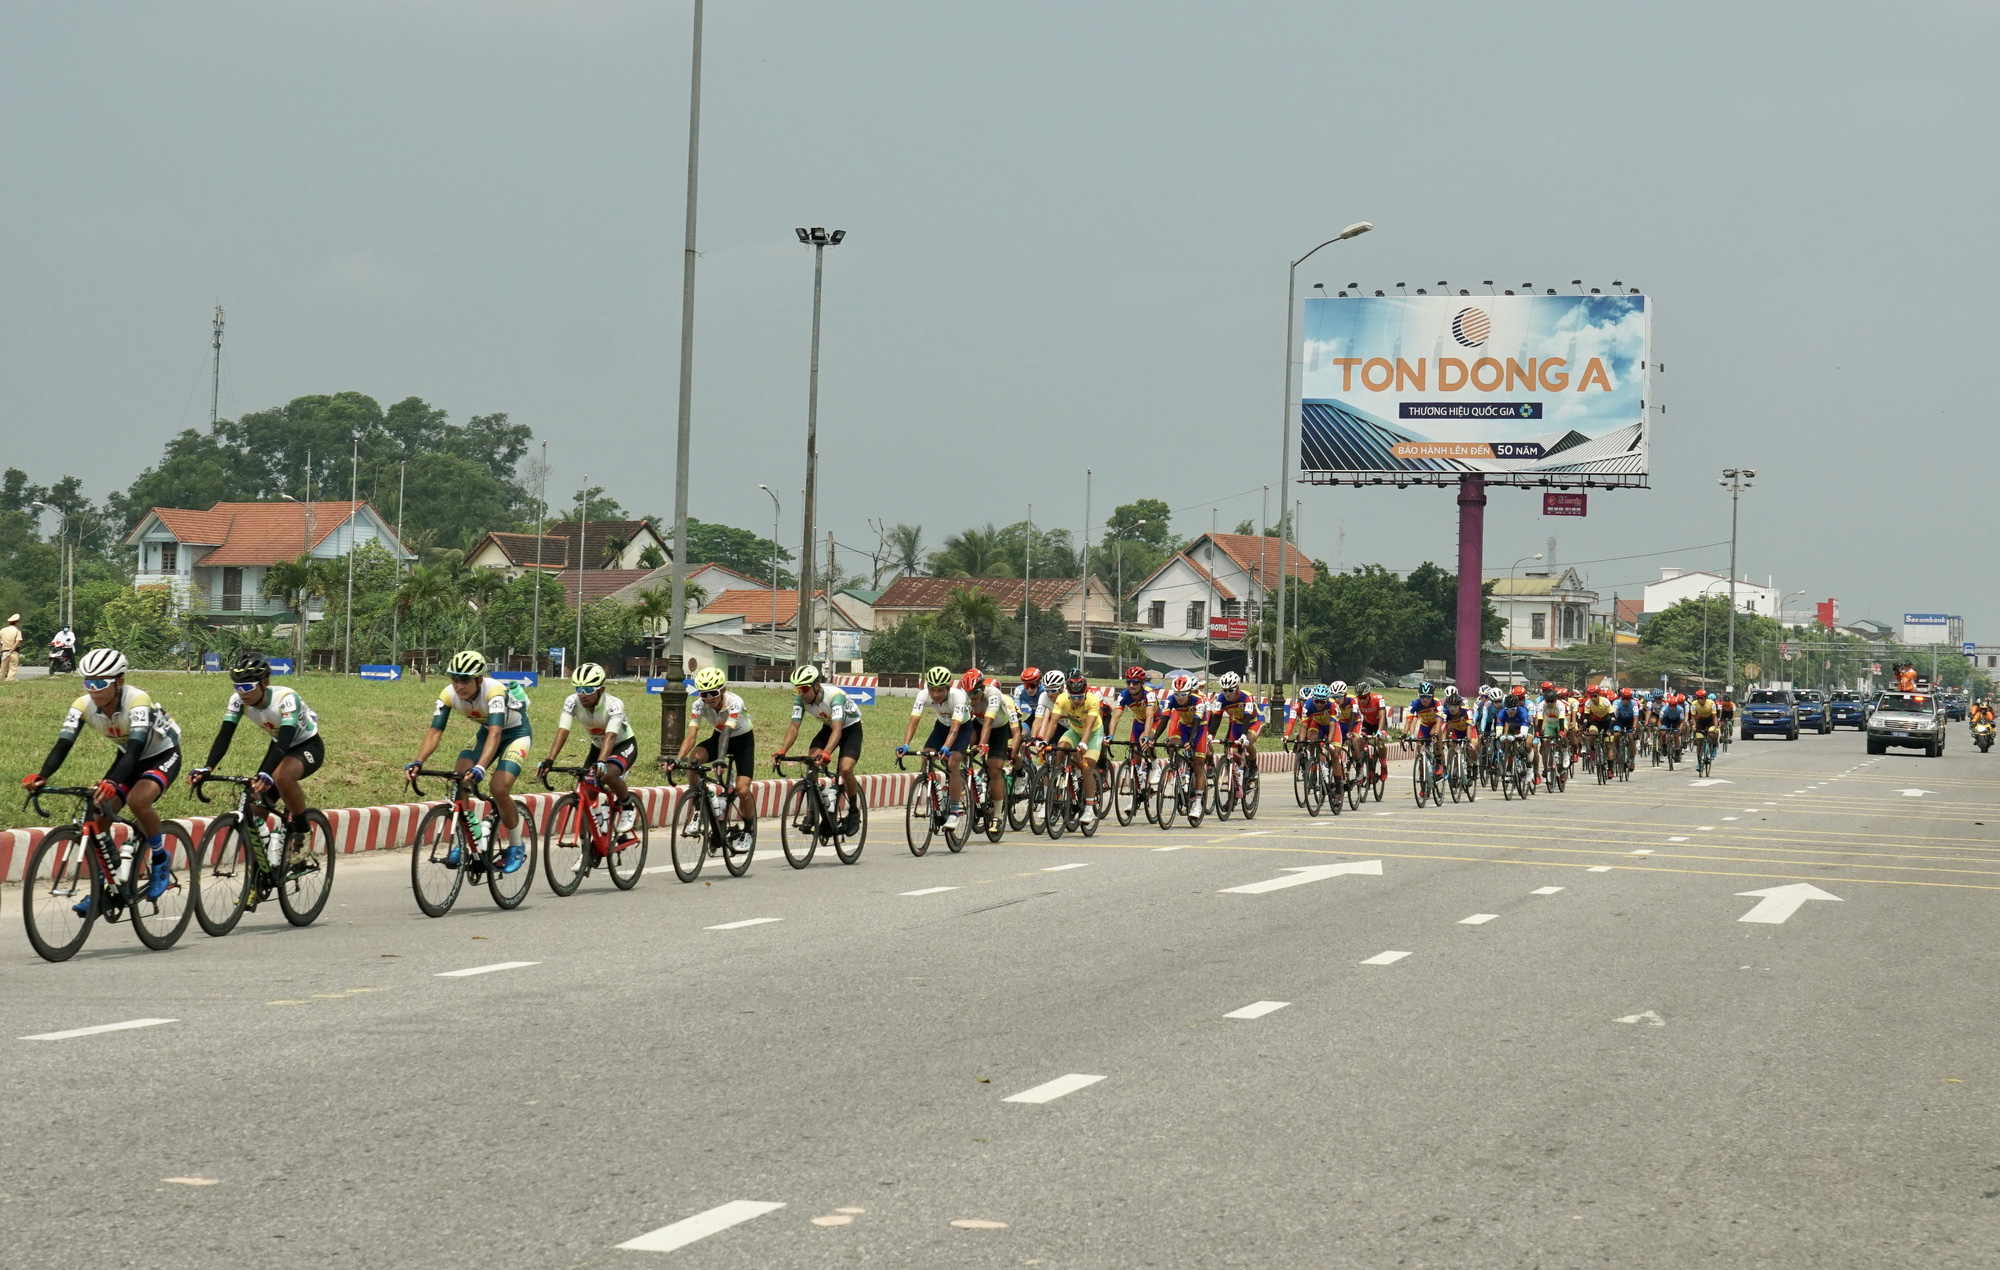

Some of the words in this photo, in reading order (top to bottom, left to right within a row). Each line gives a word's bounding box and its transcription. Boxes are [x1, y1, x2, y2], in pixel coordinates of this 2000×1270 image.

[1333, 357, 1426, 392] TON
[1438, 357, 1569, 392] DONG
[1577, 357, 1612, 392] A
[1408, 406, 1447, 416] THƯƠNG
[1449, 406, 1470, 417] HIỆU
[1471, 405, 1498, 416] QUỐC
[1499, 407, 1515, 416] GIA
[1398, 445, 1418, 455] BẢO
[1420, 445, 1448, 455] HÀNH
[1449, 445, 1468, 455] LÊN
[1470, 444, 1490, 455] ĐẾN
[1497, 445, 1513, 455] 50
[1515, 445, 1538, 455] NĂM
[1905, 615, 1946, 623] Sacombank
